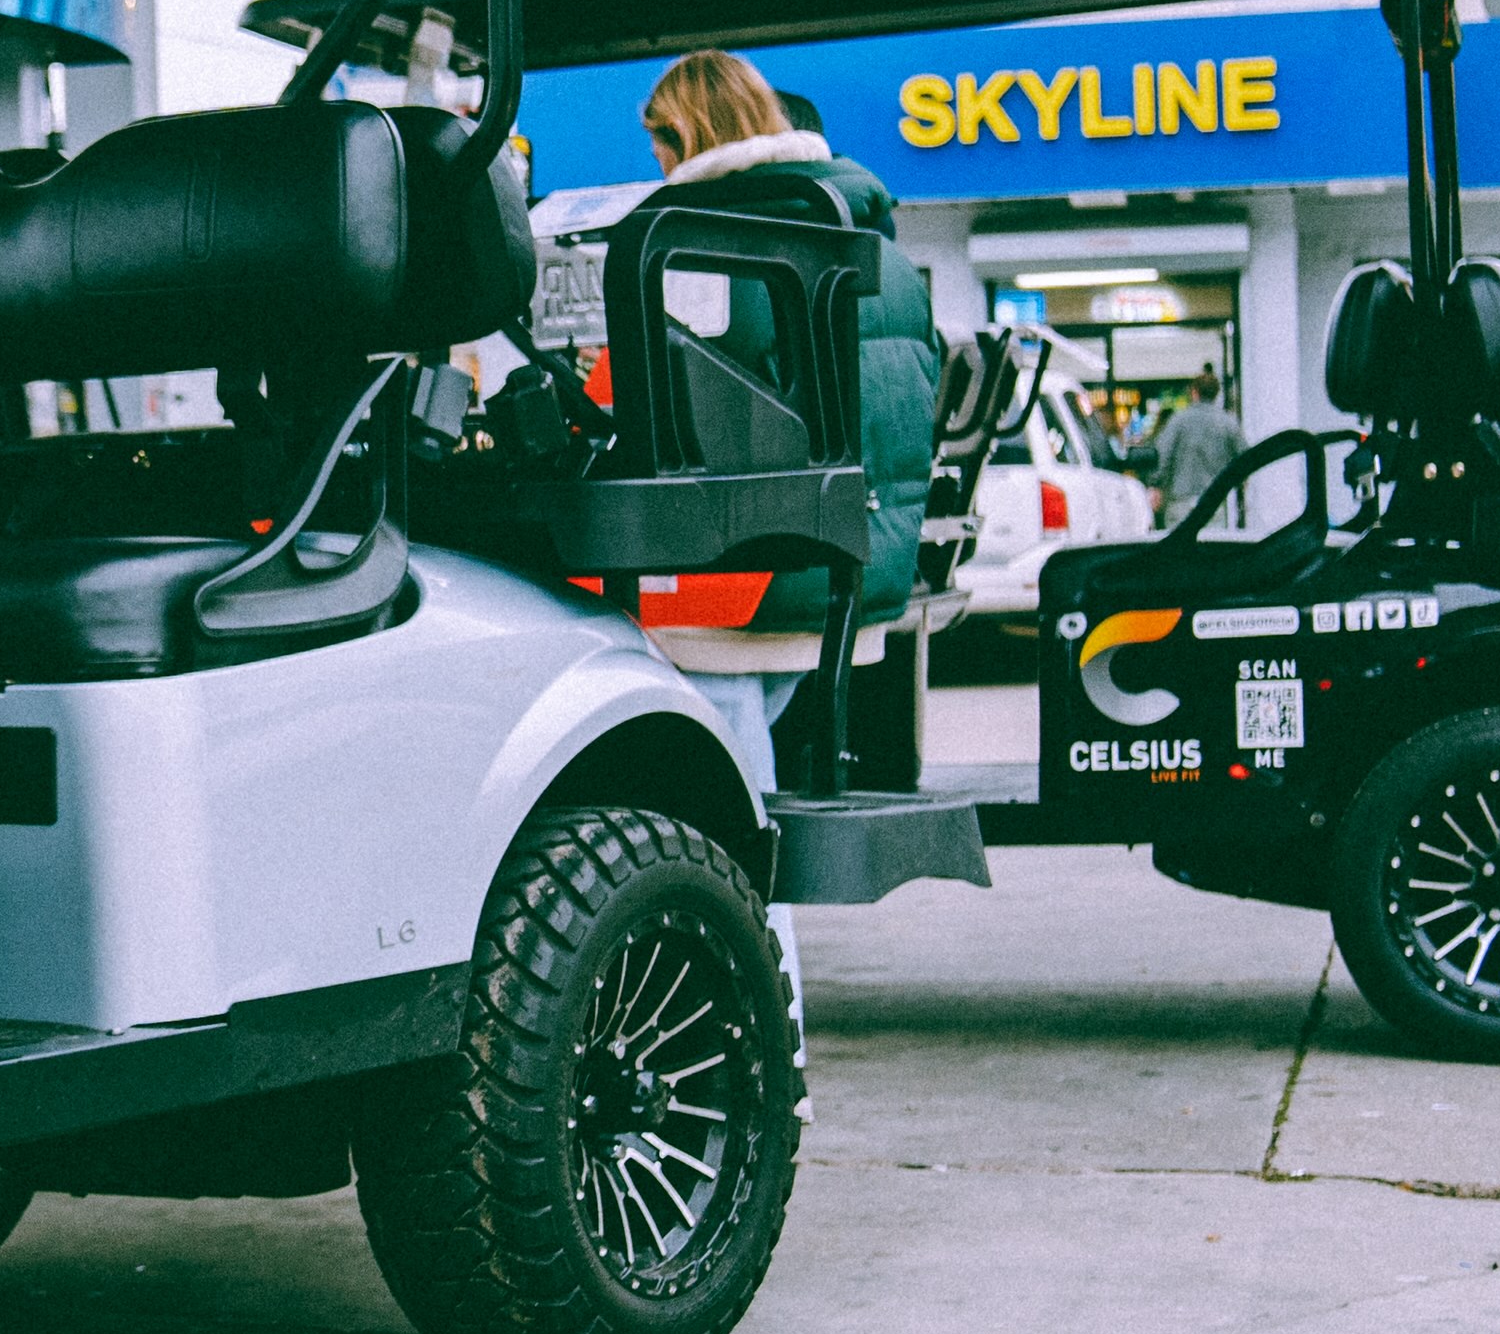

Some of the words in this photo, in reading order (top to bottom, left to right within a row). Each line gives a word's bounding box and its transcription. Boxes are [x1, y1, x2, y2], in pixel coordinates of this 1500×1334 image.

[899, 55, 1281, 148] SKYLINE
[1238, 659, 1297, 680] SCAN
[1069, 738, 1202, 772] CELSIUS
[1254, 749, 1285, 768] ME
[1151, 771, 1178, 784] LIVE
[1181, 769, 1201, 782] FIT
[377, 919, 417, 950] L6
